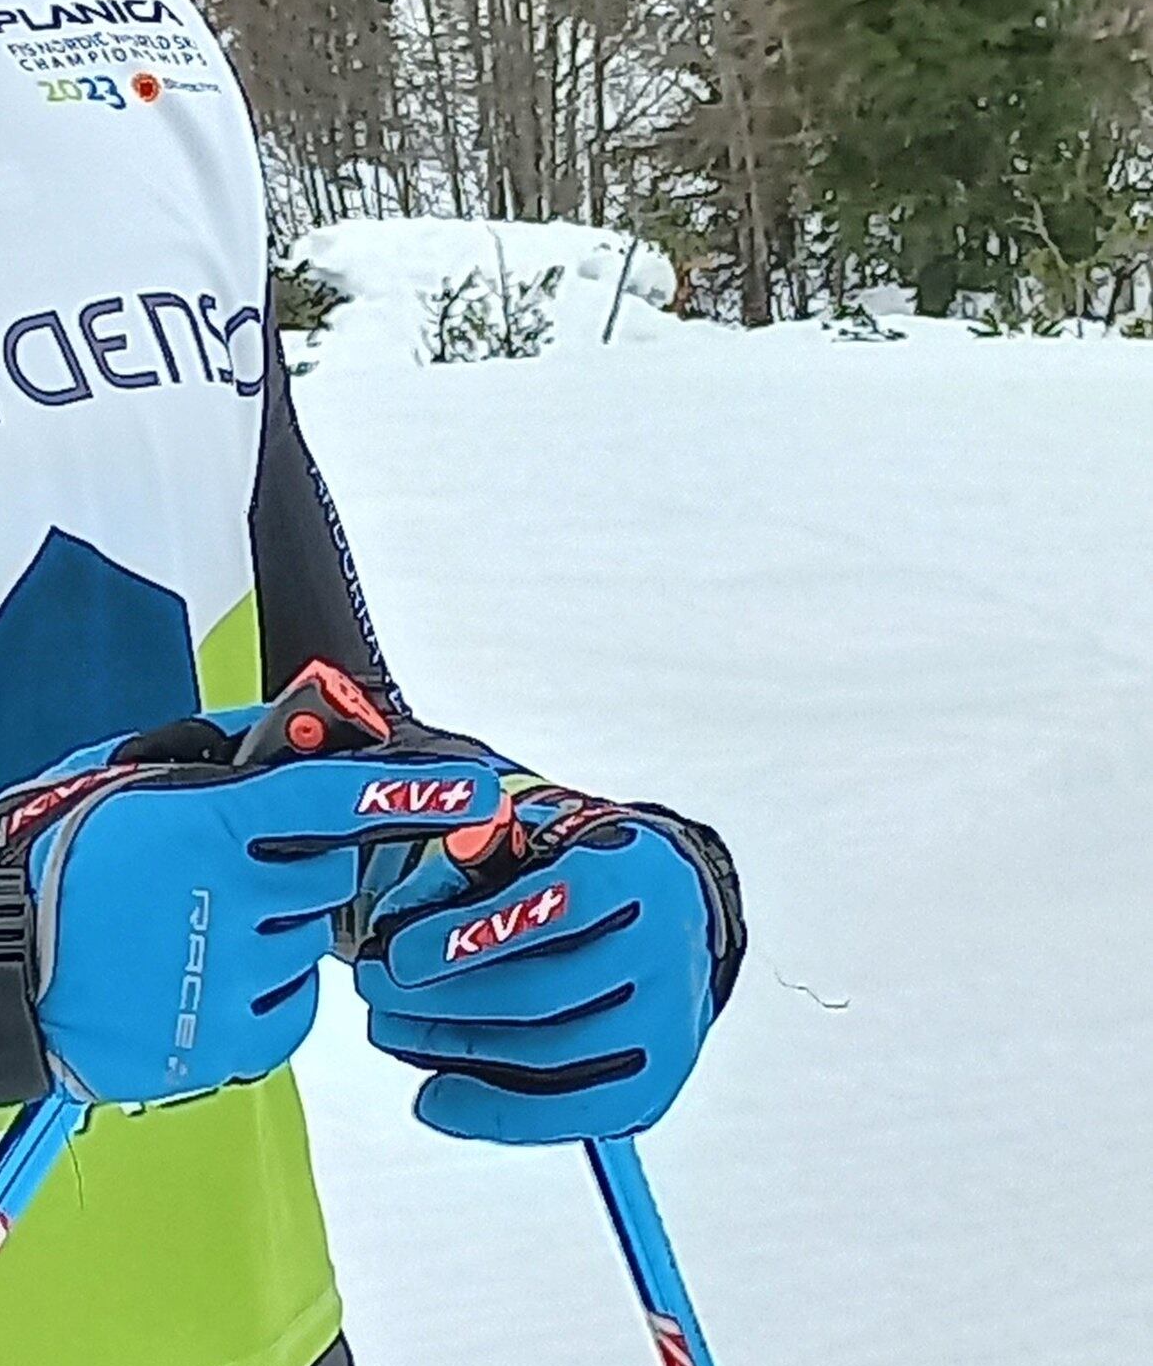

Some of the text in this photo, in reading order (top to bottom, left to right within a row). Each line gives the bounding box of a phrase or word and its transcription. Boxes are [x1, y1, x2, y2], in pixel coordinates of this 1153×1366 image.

[37, 75, 127, 110] 2023
[357, 778, 475, 815] KV+
[445, 883, 567, 961] KV+
